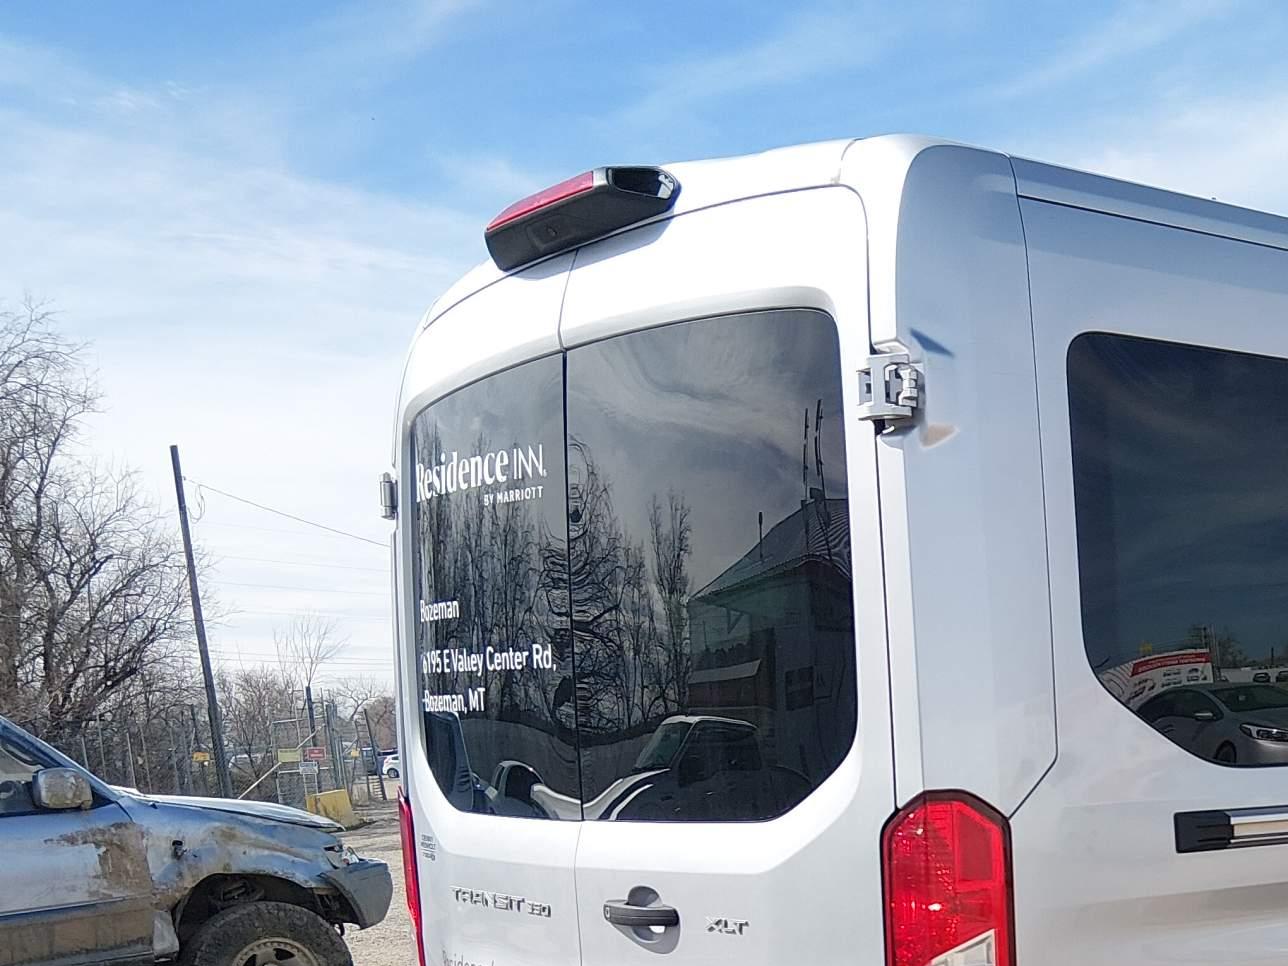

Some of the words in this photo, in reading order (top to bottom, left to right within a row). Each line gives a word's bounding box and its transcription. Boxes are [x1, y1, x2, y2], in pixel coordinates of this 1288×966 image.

[415, 448, 508, 503] Residence
[483, 493, 494, 506] BY
[496, 485, 544, 504] MARRIOTT
[420, 599, 460, 623] Bozeman
[422, 648, 442, 674] 6195
[443, 648, 451, 673] E
[451, 647, 484, 678] Valley
[485, 645, 529, 672] Center
[532, 642, 557, 672] Rd,
[468, 686, 486, 712] MT
[450, 885, 526, 913] TRANSIT
[705, 916, 750, 936] XLT
